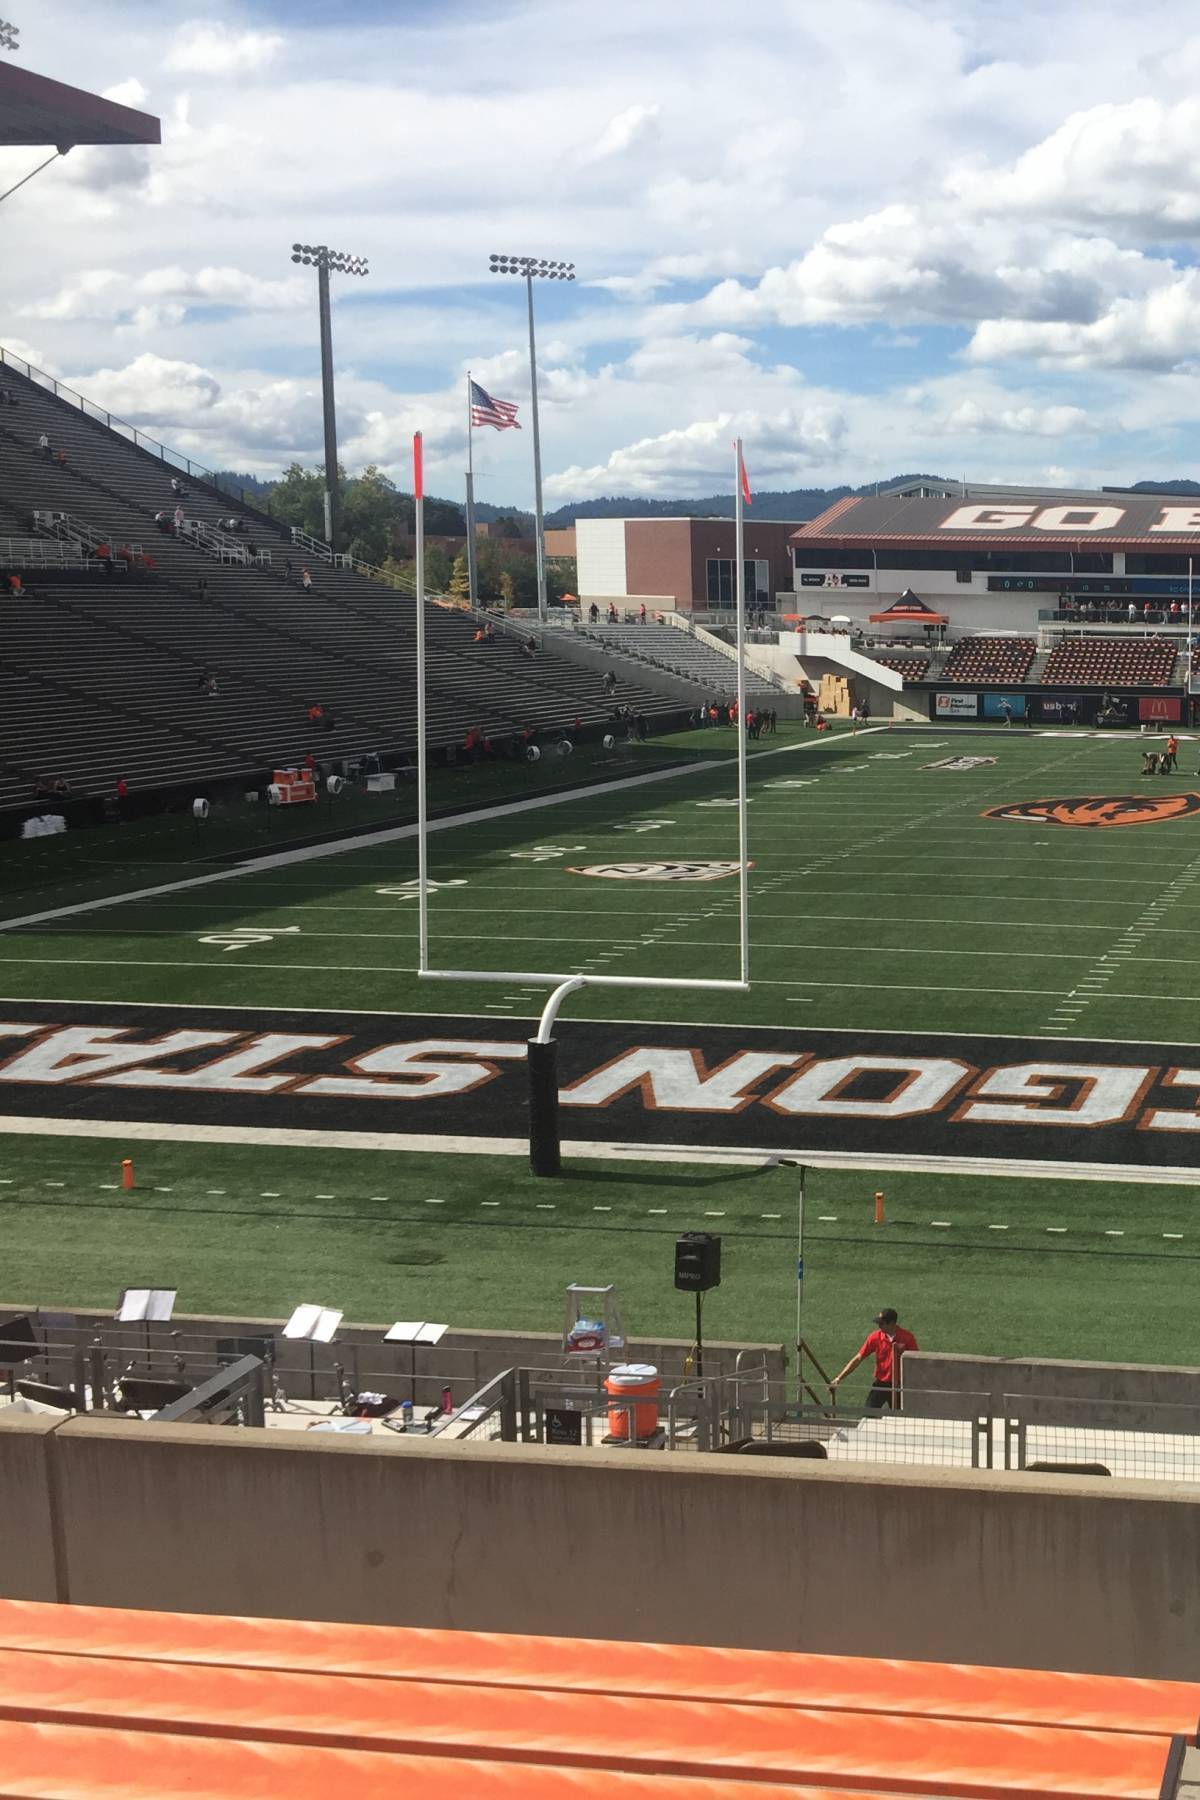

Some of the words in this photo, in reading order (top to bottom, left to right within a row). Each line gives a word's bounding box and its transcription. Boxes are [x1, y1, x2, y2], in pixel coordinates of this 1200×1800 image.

[937, 504, 1128, 531] GO
[198, 926, 301, 944] 10
[0, 1021, 529, 1098] STA
